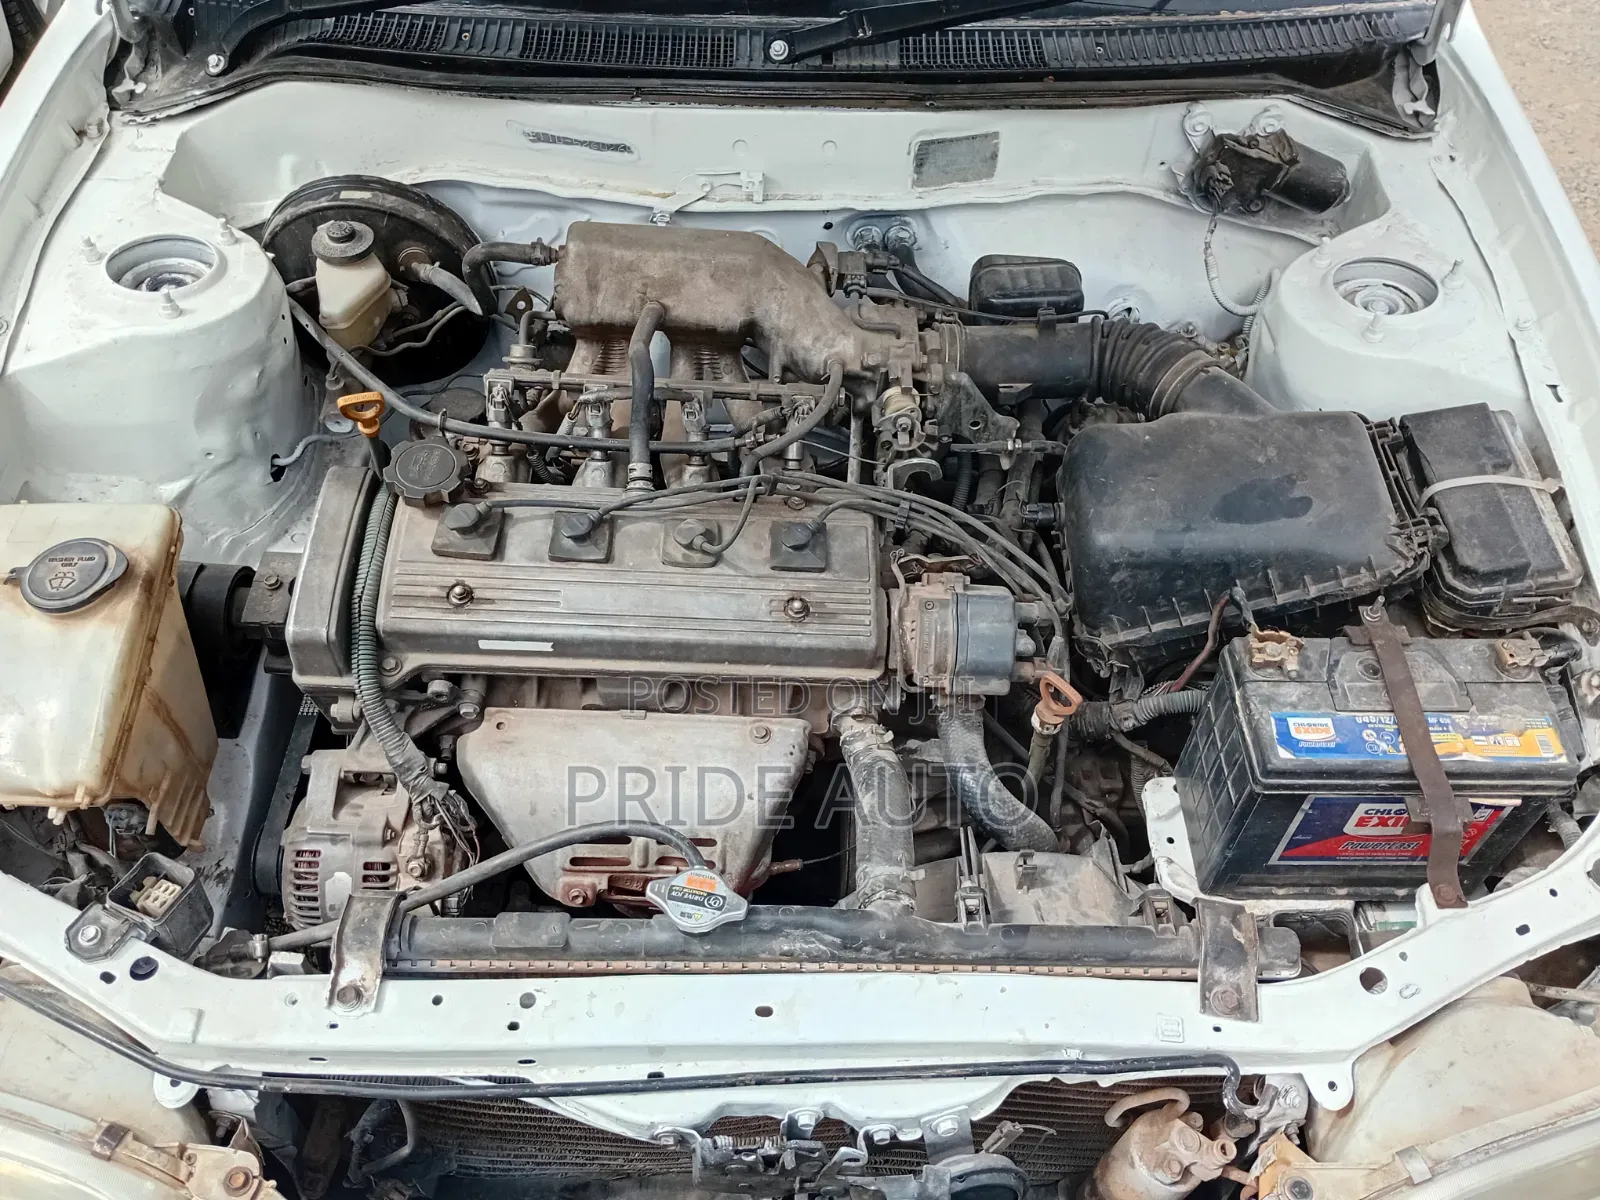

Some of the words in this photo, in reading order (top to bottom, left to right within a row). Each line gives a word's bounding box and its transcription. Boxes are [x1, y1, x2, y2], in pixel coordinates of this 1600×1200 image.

[1294, 727, 1332, 735] EXIDE
[1363, 808, 1409, 816] CHLO
[684, 893, 705, 902] DRIVE
